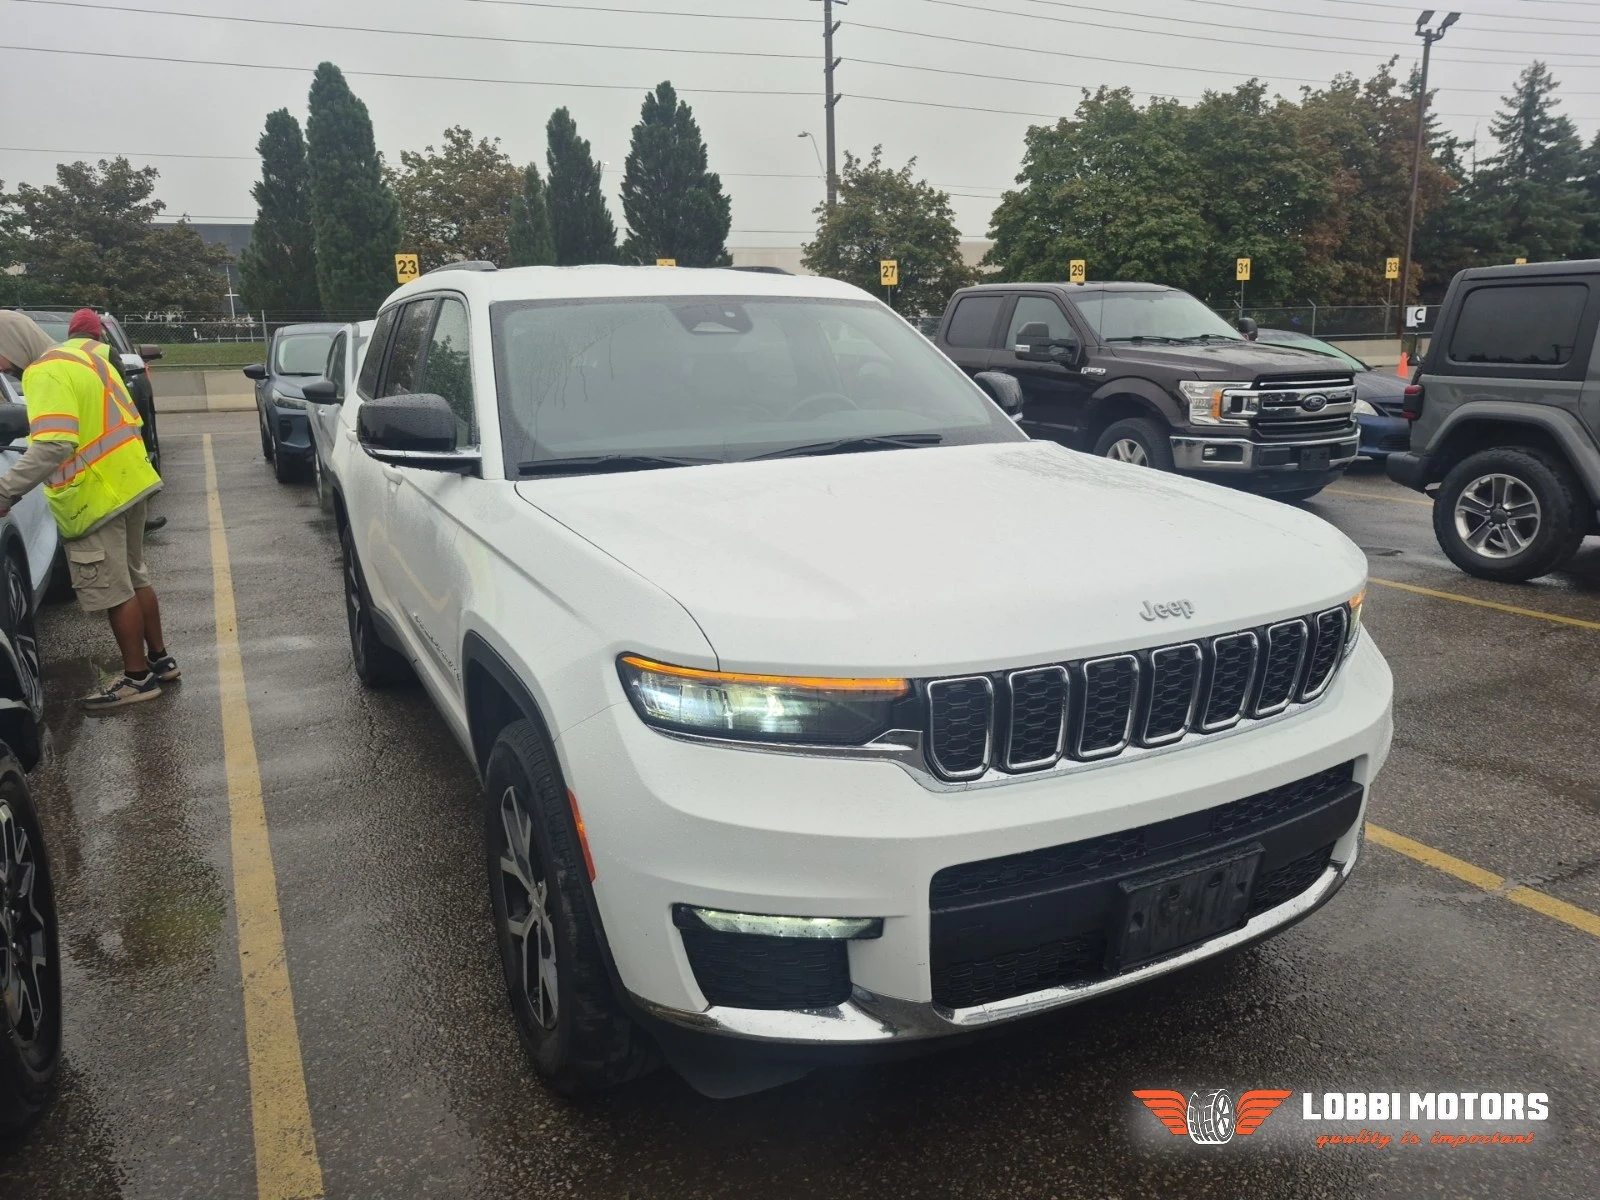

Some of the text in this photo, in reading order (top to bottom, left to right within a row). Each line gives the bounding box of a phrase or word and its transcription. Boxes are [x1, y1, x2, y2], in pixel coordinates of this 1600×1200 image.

[397, 259, 418, 275] 23
[882, 265, 896, 278] 27
[1071, 264, 1084, 277] 29
[1237, 262, 1249, 274] 31
[1387, 261, 1398, 273] 33
[1414, 308, 1424, 321] C
[1139, 599, 1194, 622] Jeep
